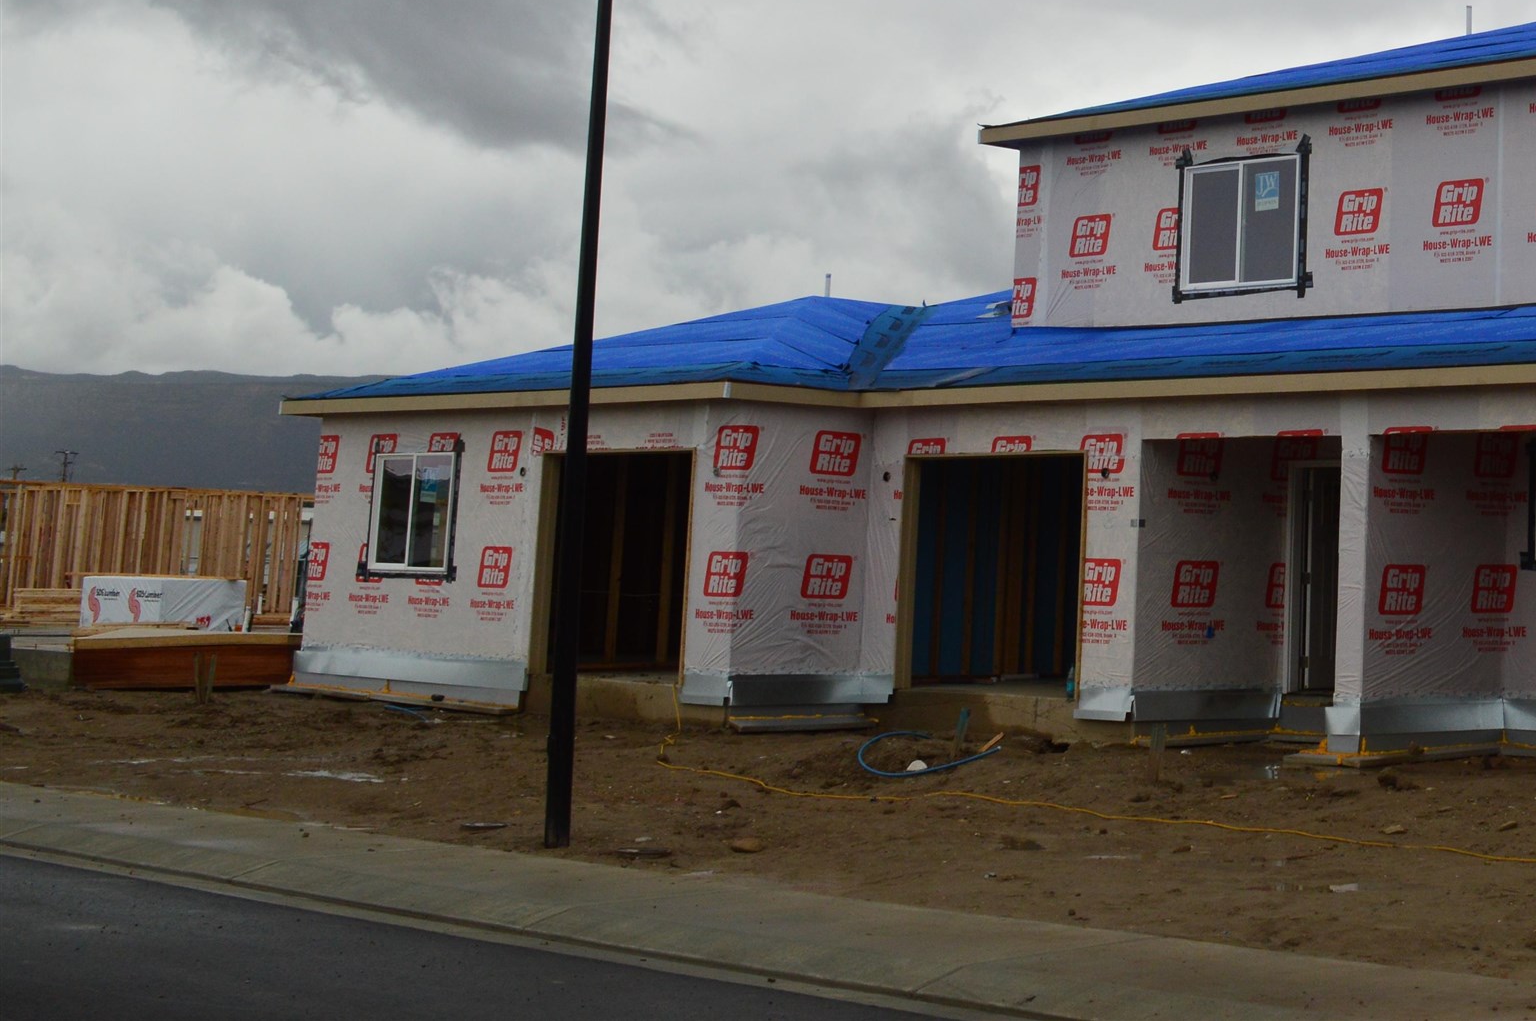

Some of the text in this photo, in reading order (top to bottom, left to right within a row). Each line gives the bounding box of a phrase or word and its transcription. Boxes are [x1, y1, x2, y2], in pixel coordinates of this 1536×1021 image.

[1427, 108, 1494, 125] House-Wrap-LWE
[1329, 119, 1393, 136] House-Wrap-LWE
[1236, 131, 1298, 147] House-Wrap-LWE
[1066, 150, 1122, 165] House-Wrap-LWE
[1441, 183, 1477, 203] Grip
[1342, 193, 1377, 212] Grip
[1340, 214, 1373, 232] Rite
[1439, 206, 1473, 223] Rite
[1076, 219, 1105, 237] Grip
[1075, 234, 1103, 253] Rite
[1325, 244, 1390, 259] House-Wrap-LWE
[1423, 236, 1491, 251] House-Wrap-LWE
[1062, 265, 1116, 279] House-Wrap-LWE
[494, 434, 521, 453] Grip
[721, 429, 753, 449] Grip
[819, 434, 855, 456] Grip
[1085, 438, 1117, 457] Grip
[492, 453, 514, 469] Rite
[718, 449, 748, 467] Rite
[816, 454, 851, 473] Rite
[480, 483, 524, 493] House-Wrap-LWE
[705, 482, 764, 494] House-Wrap-LWE
[800, 485, 866, 500] House-Wrap-LWE
[1374, 486, 1434, 500] House-Wrap-LWE
[483, 550, 507, 568] Grip
[711, 555, 741, 575] Grip
[810, 558, 846, 578] Grip
[1181, 565, 1213, 585] Grip
[482, 569, 504, 585] Rite
[708, 576, 737, 594] Rite
[1387, 569, 1420, 590] Grip
[1479, 569, 1510, 590] Grip
[807, 579, 841, 596] Rite
[1178, 585, 1209, 604] Rite
[349, 593, 389, 603] House-Wrap-LWE
[408, 596, 450, 607] House-Wrap-LWE
[470, 599, 514, 609] House-Wrap-LWE
[1385, 591, 1416, 611] Rite
[1477, 591, 1507, 609] Rite
[695, 609, 754, 620] House-Wrap-LWE
[791, 611, 857, 622] House-Wrap-LWE
[1369, 628, 1432, 639] House-Wrap-LWE
[1463, 626, 1526, 637] House-Wrap-LWE
